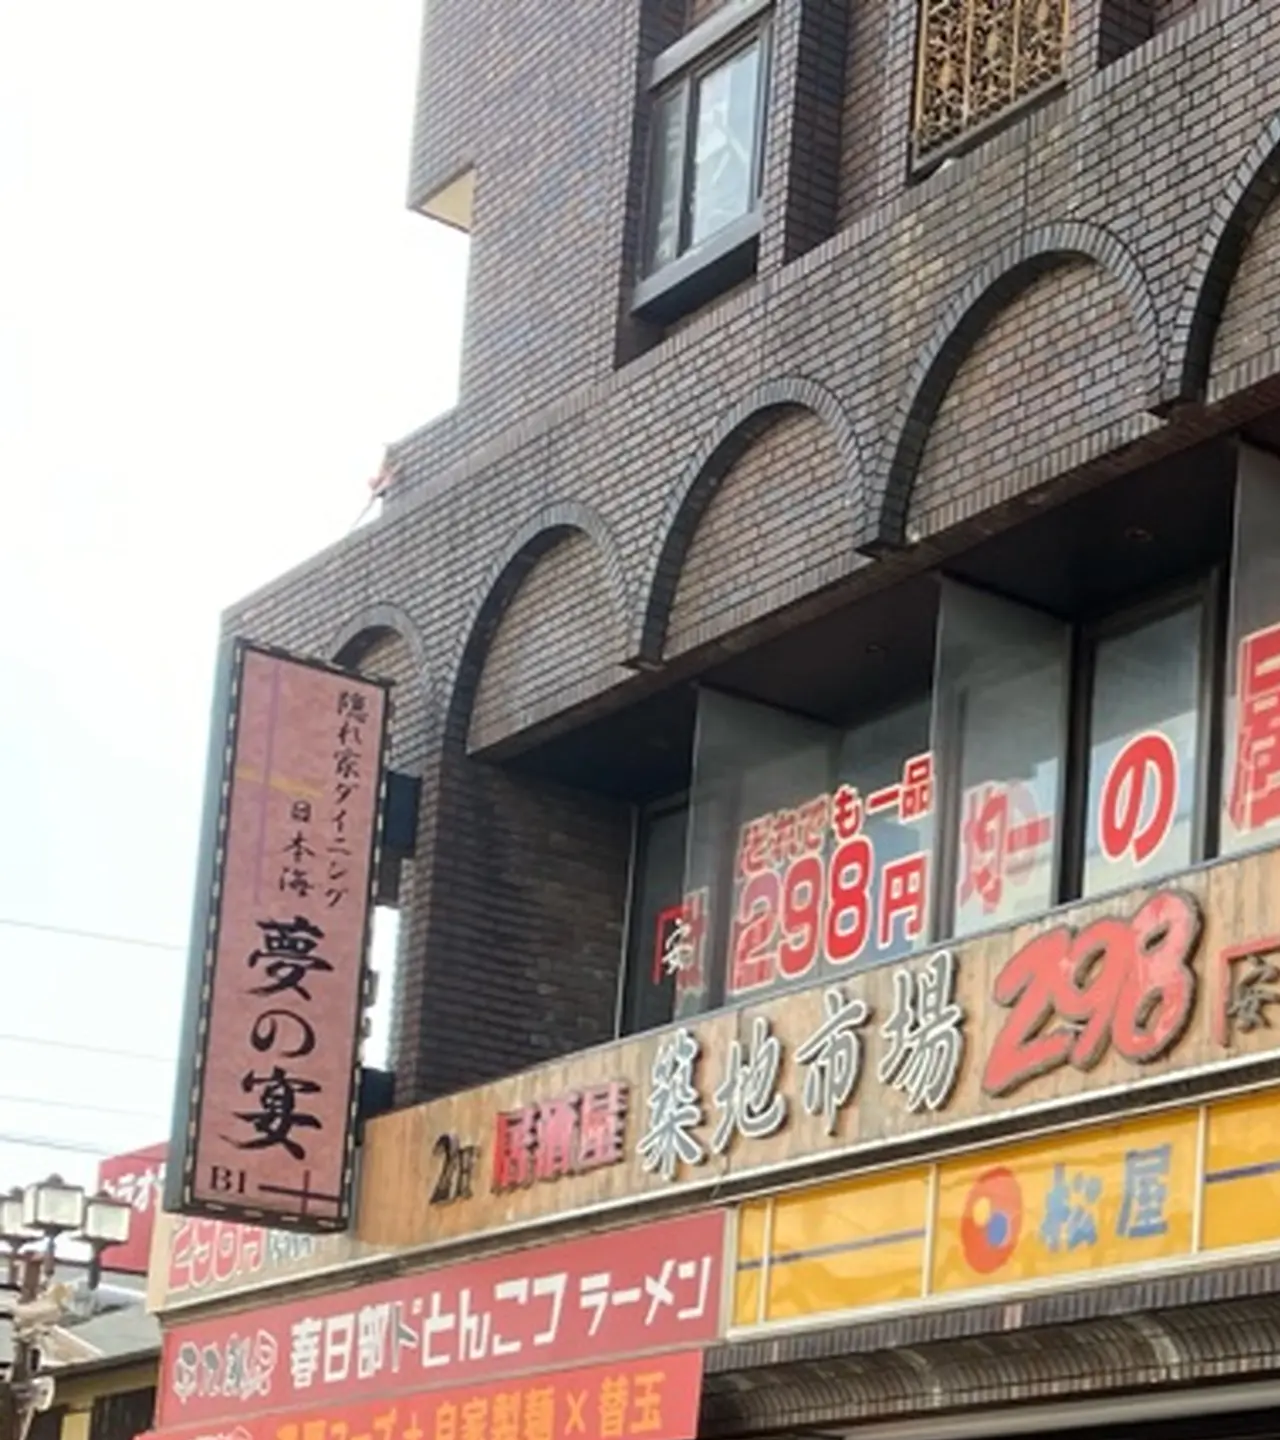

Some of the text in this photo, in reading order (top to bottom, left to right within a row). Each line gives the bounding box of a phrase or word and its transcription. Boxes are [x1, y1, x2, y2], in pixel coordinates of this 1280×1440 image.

[277, 801, 316, 898] 日本海
[326, 690, 369, 908] 隠れ家ダイニング
[732, 835, 929, 994] 298円
[220, 916, 334, 1160] 夢の宴
[637, 951, 965, 1180] 築地市場
[983, 888, 1205, 1097] 298
[208, 1165, 248, 1194] B1
[1041, 1143, 1172, 1251] 松屋
